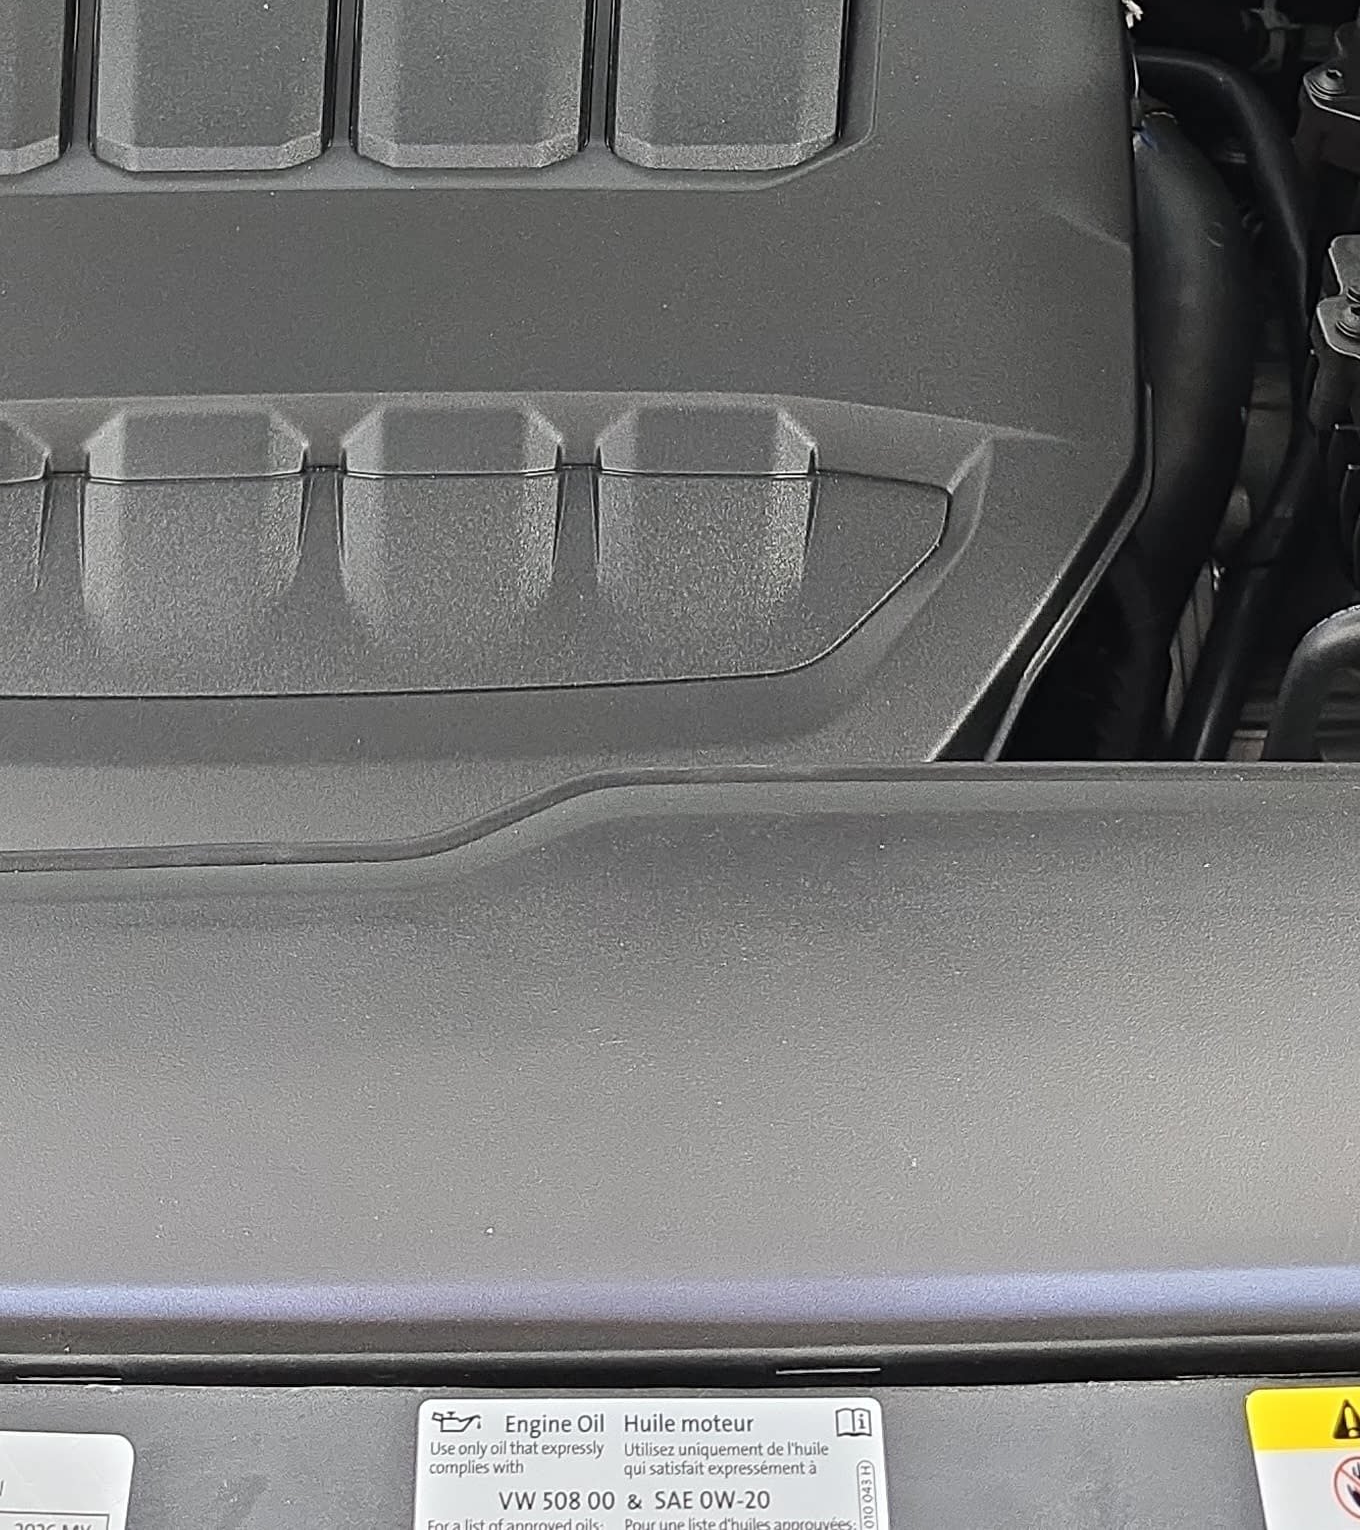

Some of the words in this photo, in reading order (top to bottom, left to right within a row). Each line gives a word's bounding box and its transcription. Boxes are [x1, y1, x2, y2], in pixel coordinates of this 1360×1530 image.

[506, 1415, 572, 1438] Engine
[577, 1415, 605, 1433] Oil
[624, 1415, 676, 1433] Huile
[682, 1416, 754, 1433] moteur
[430, 1442, 456, 1456] Use
[458, 1441, 488, 1459] only
[490, 1441, 507, 1456] oil
[509, 1441, 539, 1456] that
[541, 1441, 604, 1459] expressly
[624, 1442, 675, 1457] Utilisez
[678, 1443, 763, 1461] uniquement
[767, 1442, 784, 1457] de
[787, 1442, 829, 1457] l'huile
[429, 1459, 489, 1478] complies
[492, 1459, 524, 1474] with
[624, 1460, 645, 1478] qui
[648, 1460, 705, 1476] satisfait
[708, 1460, 806, 1478] expressément
[808, 1460, 818, 1475] à
[861, 1466, 871, 1475] H
[498, 1491, 536, 1511] VW
[542, 1491, 581, 1511] 508
[588, 1491, 616, 1511] 00
[627, 1493, 643, 1511] &
[655, 1491, 694, 1510] SAE
[699, 1490, 771, 1510] 0W-20
[428, 1519, 451, 1530] For
[464, 1519, 485, 1530] list
[488, 1519, 503, 1530] of
